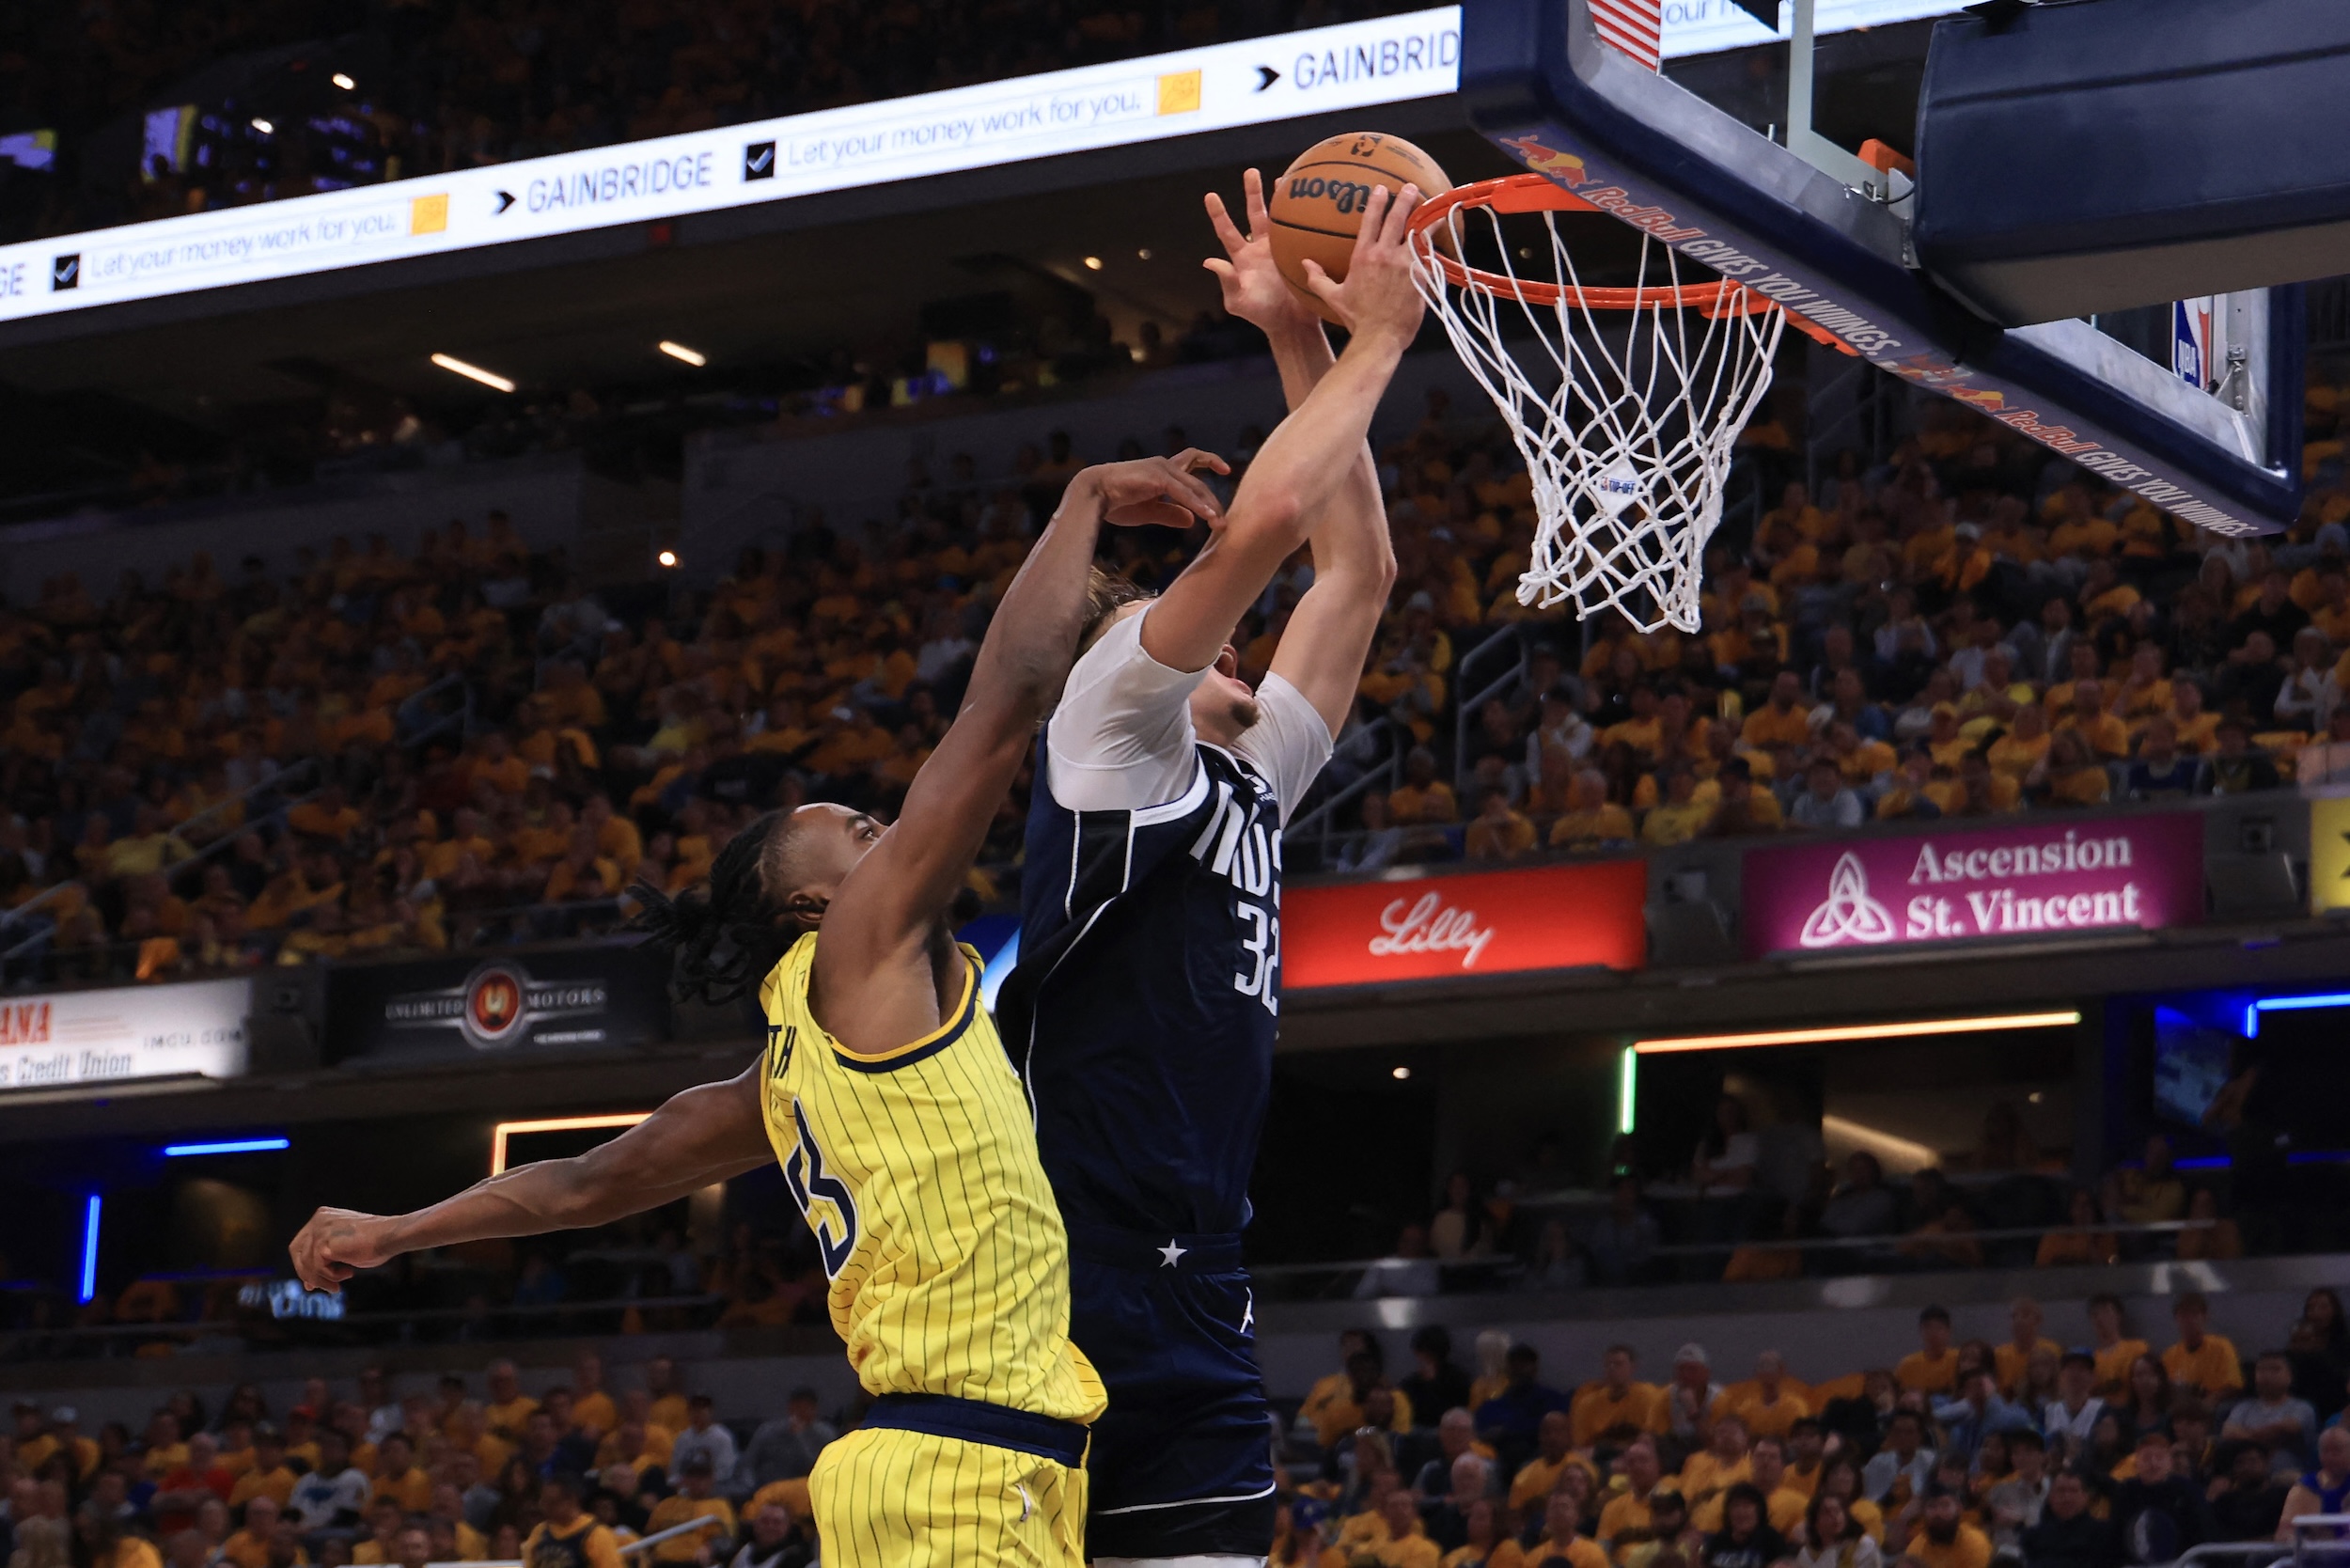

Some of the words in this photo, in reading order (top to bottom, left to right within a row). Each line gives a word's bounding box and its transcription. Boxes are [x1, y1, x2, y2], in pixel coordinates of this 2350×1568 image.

[788, 140, 829, 167] Let
[833, 132, 885, 161] your
[891, 118, 977, 149] money
[982, 100, 1043, 133] work
[1049, 93, 1084, 122] for
[1089, 91, 1141, 122] you.
[526, 152, 713, 213] GAINBRIDGE
[1289, 177, 1397, 214] ilson
[1679, 239, 1769, 275] GIVES
[1745, 273, 1819, 302] YOU
[2075, 450, 2153, 481] GIVES
[2128, 478, 2193, 502] YOU
[1907, 830, 2133, 885] Ascension
[1368, 890, 1495, 969] Lilly
[1906, 894, 1965, 940] St.
[1965, 882, 2140, 933] Vincent
[526, 988, 606, 1009] MOTORS
[17, 1054, 70, 1084] Credit
[77, 1046, 133, 1078] Union
